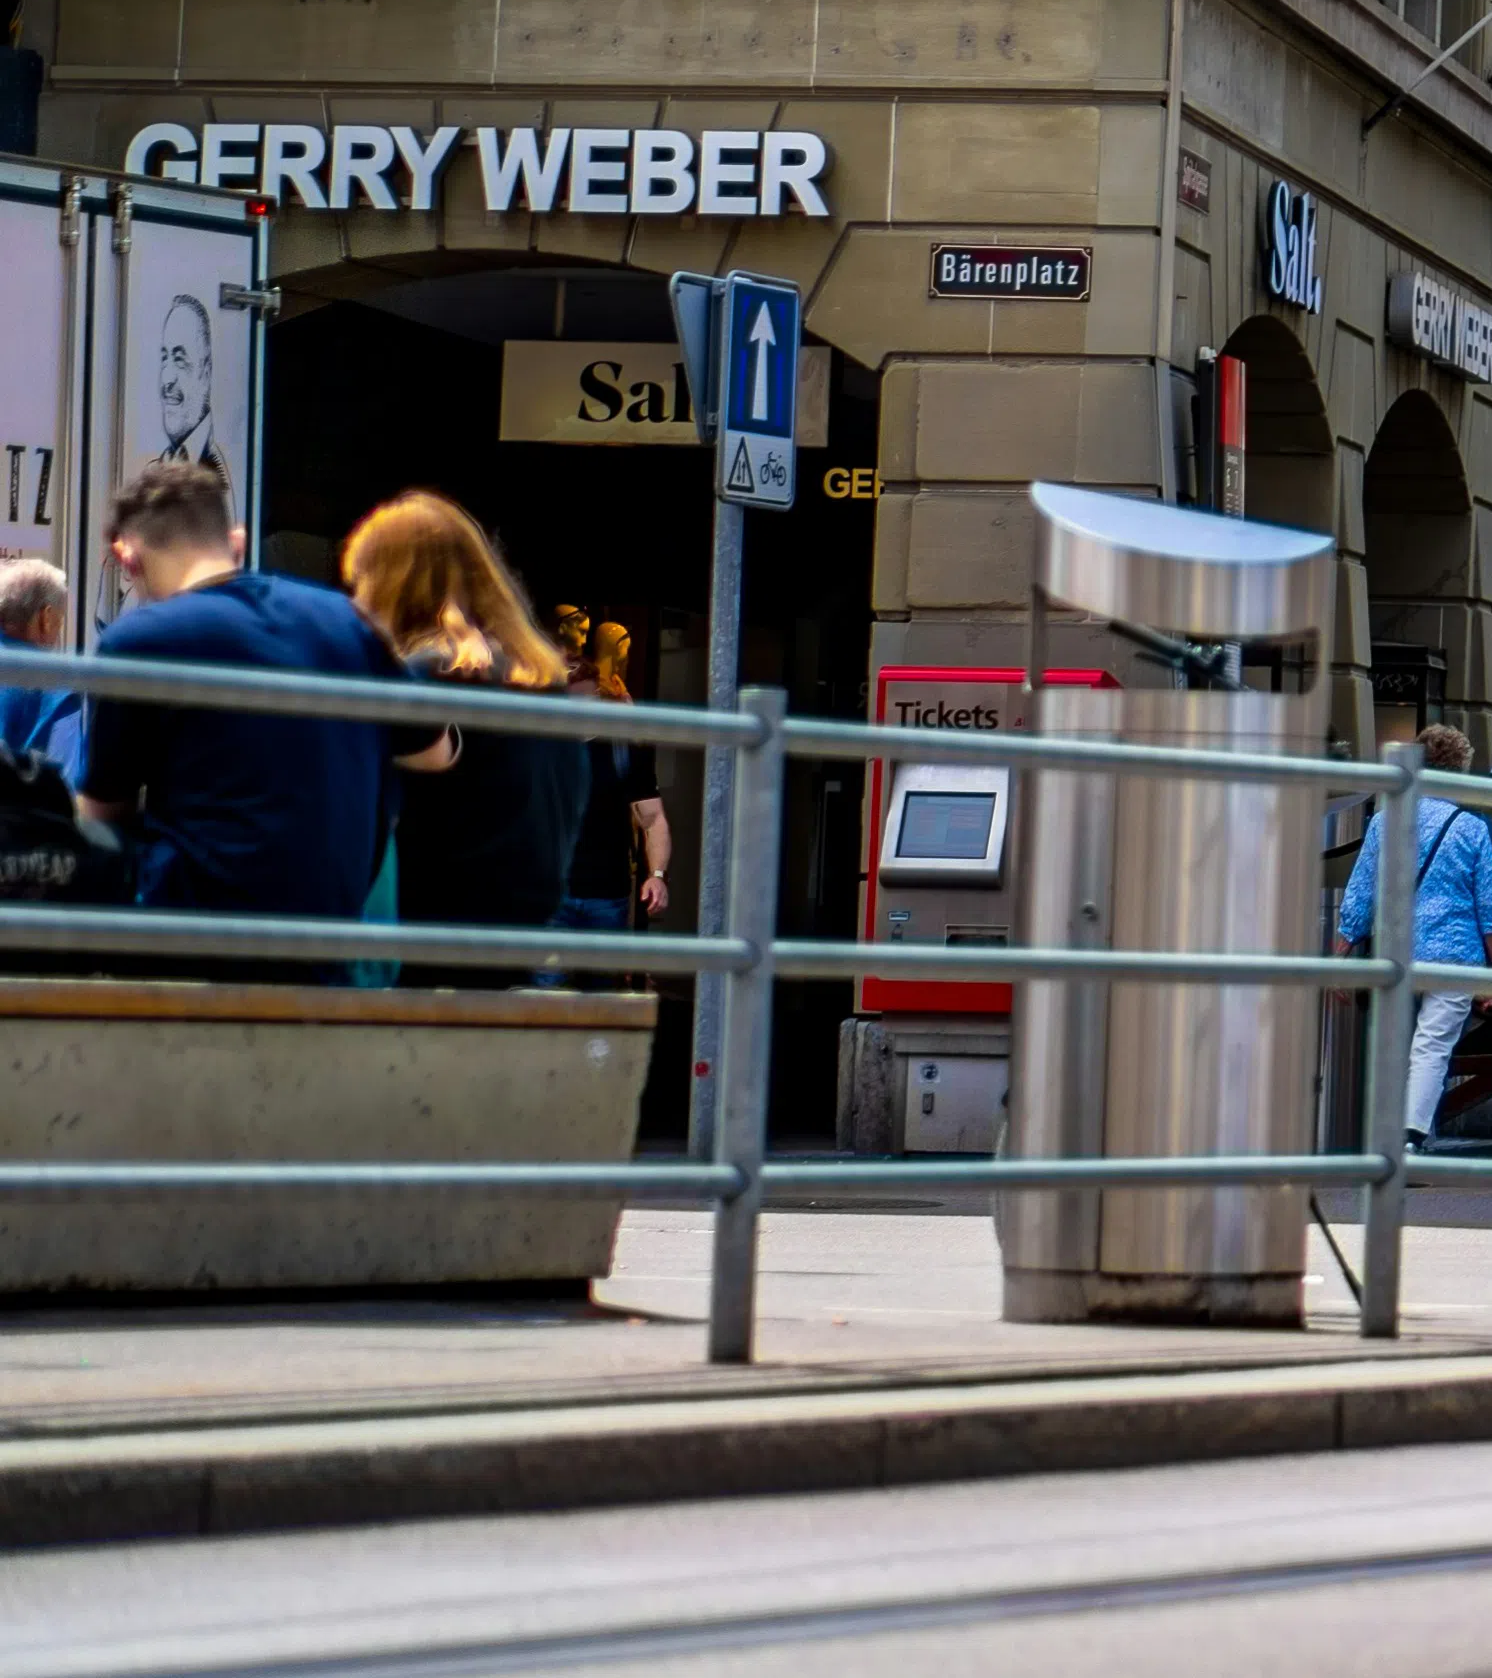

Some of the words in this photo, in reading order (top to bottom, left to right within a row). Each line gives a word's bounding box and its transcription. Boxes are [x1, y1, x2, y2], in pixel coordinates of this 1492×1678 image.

[124, 122, 462, 210] GERRY
[476, 126, 830, 216] WEBER
[940, 253, 1080, 291] Bärenplatz
[1412, 271, 1456, 361] GERRY
[577, 360, 697, 424] Sal
[895, 701, 999, 730] Tickets
